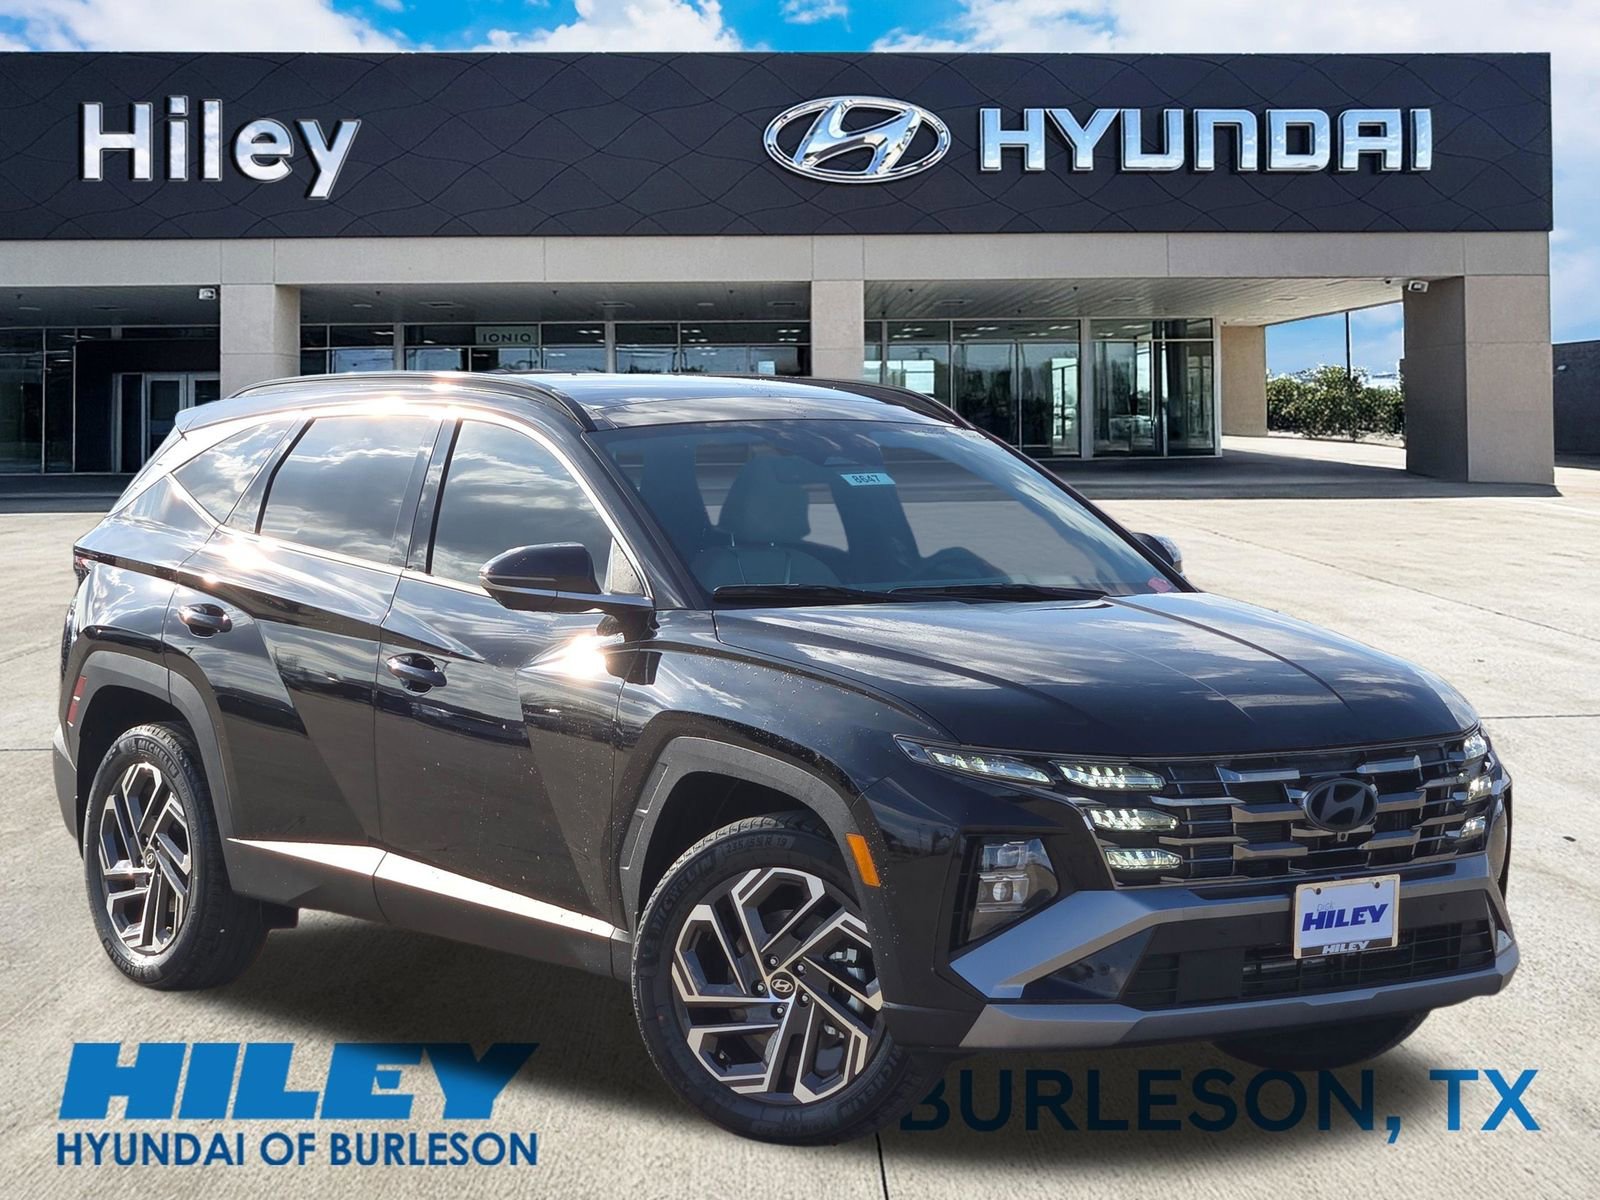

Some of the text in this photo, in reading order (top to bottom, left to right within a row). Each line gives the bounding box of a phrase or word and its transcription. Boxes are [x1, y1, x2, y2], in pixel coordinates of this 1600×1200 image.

[79, 95, 361, 200] Hiley
[979, 107, 1431, 172] HYUNDAI
[136, 739, 178, 776] MICHELIN
[651, 853, 719, 930] MICHELIN
[1302, 904, 1389, 931] HILEY
[1322, 941, 1370, 954] HILEY
